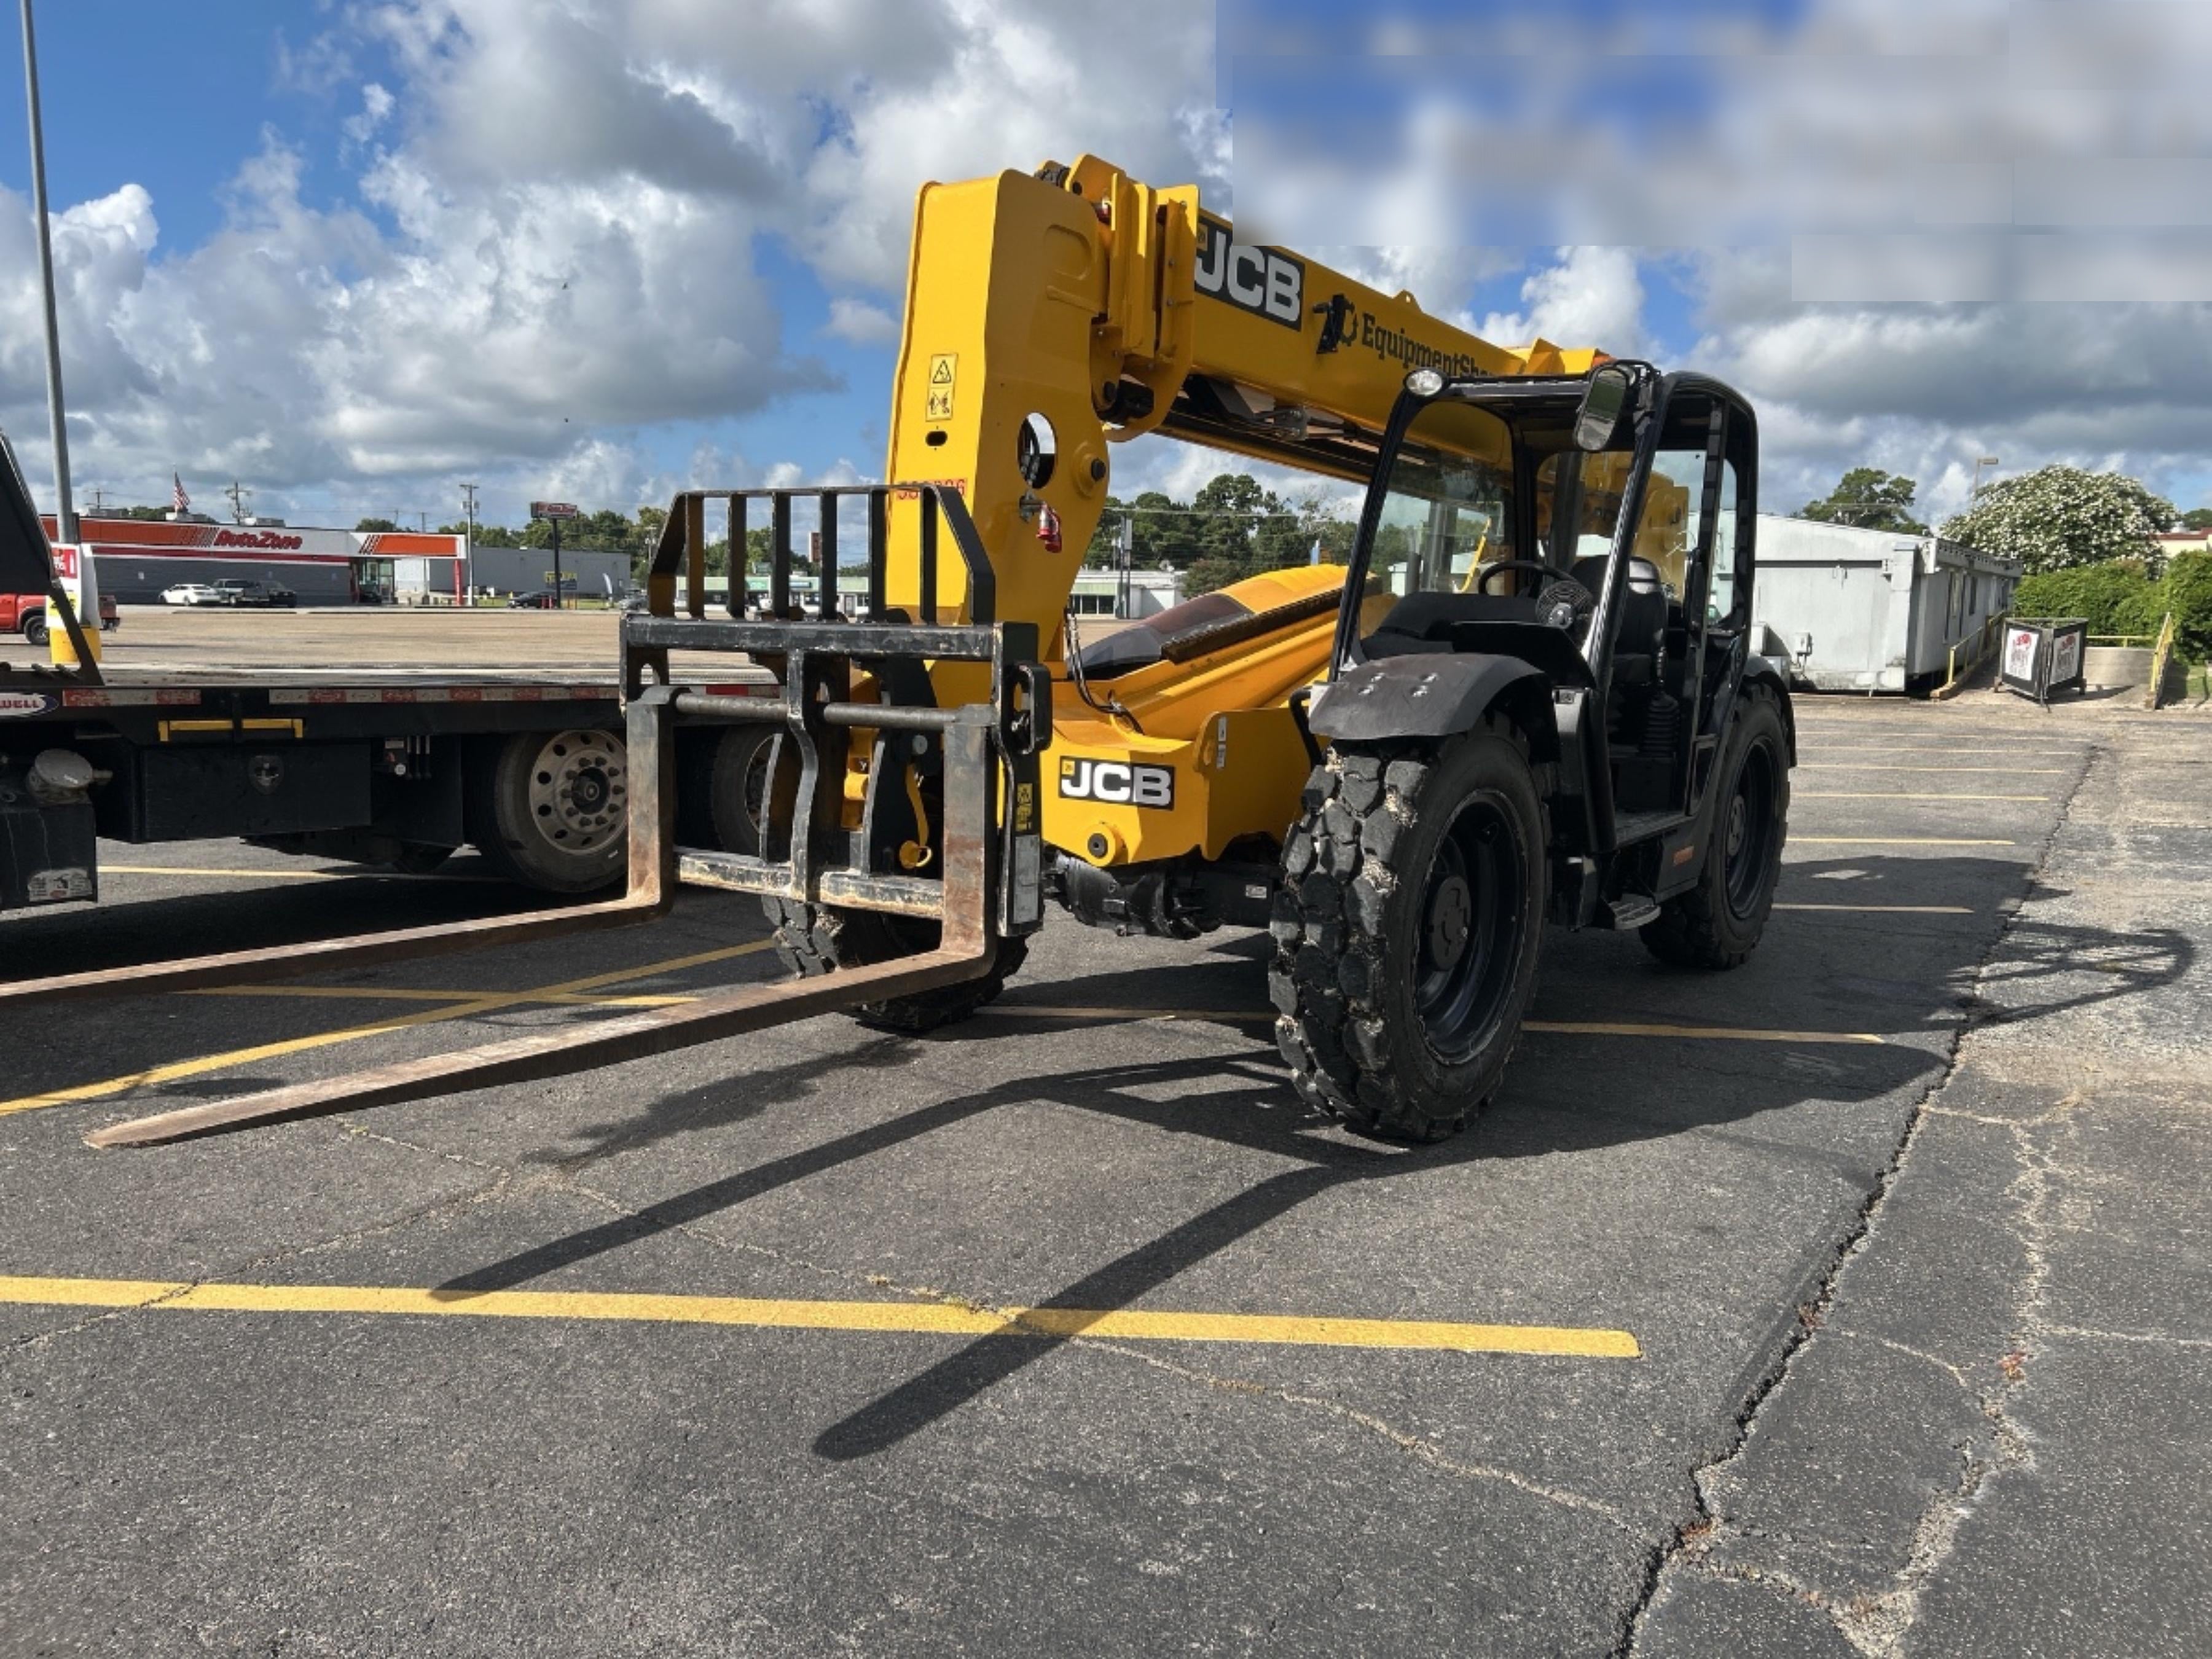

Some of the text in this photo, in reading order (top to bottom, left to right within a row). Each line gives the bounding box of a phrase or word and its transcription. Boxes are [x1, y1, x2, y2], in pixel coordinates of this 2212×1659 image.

[1195, 230, 1301, 321] JCB
[1362, 312, 1496, 377] EquipmentSh
[214, 530, 303, 550] AutoZone
[1061, 761, 1171, 806] JCB
